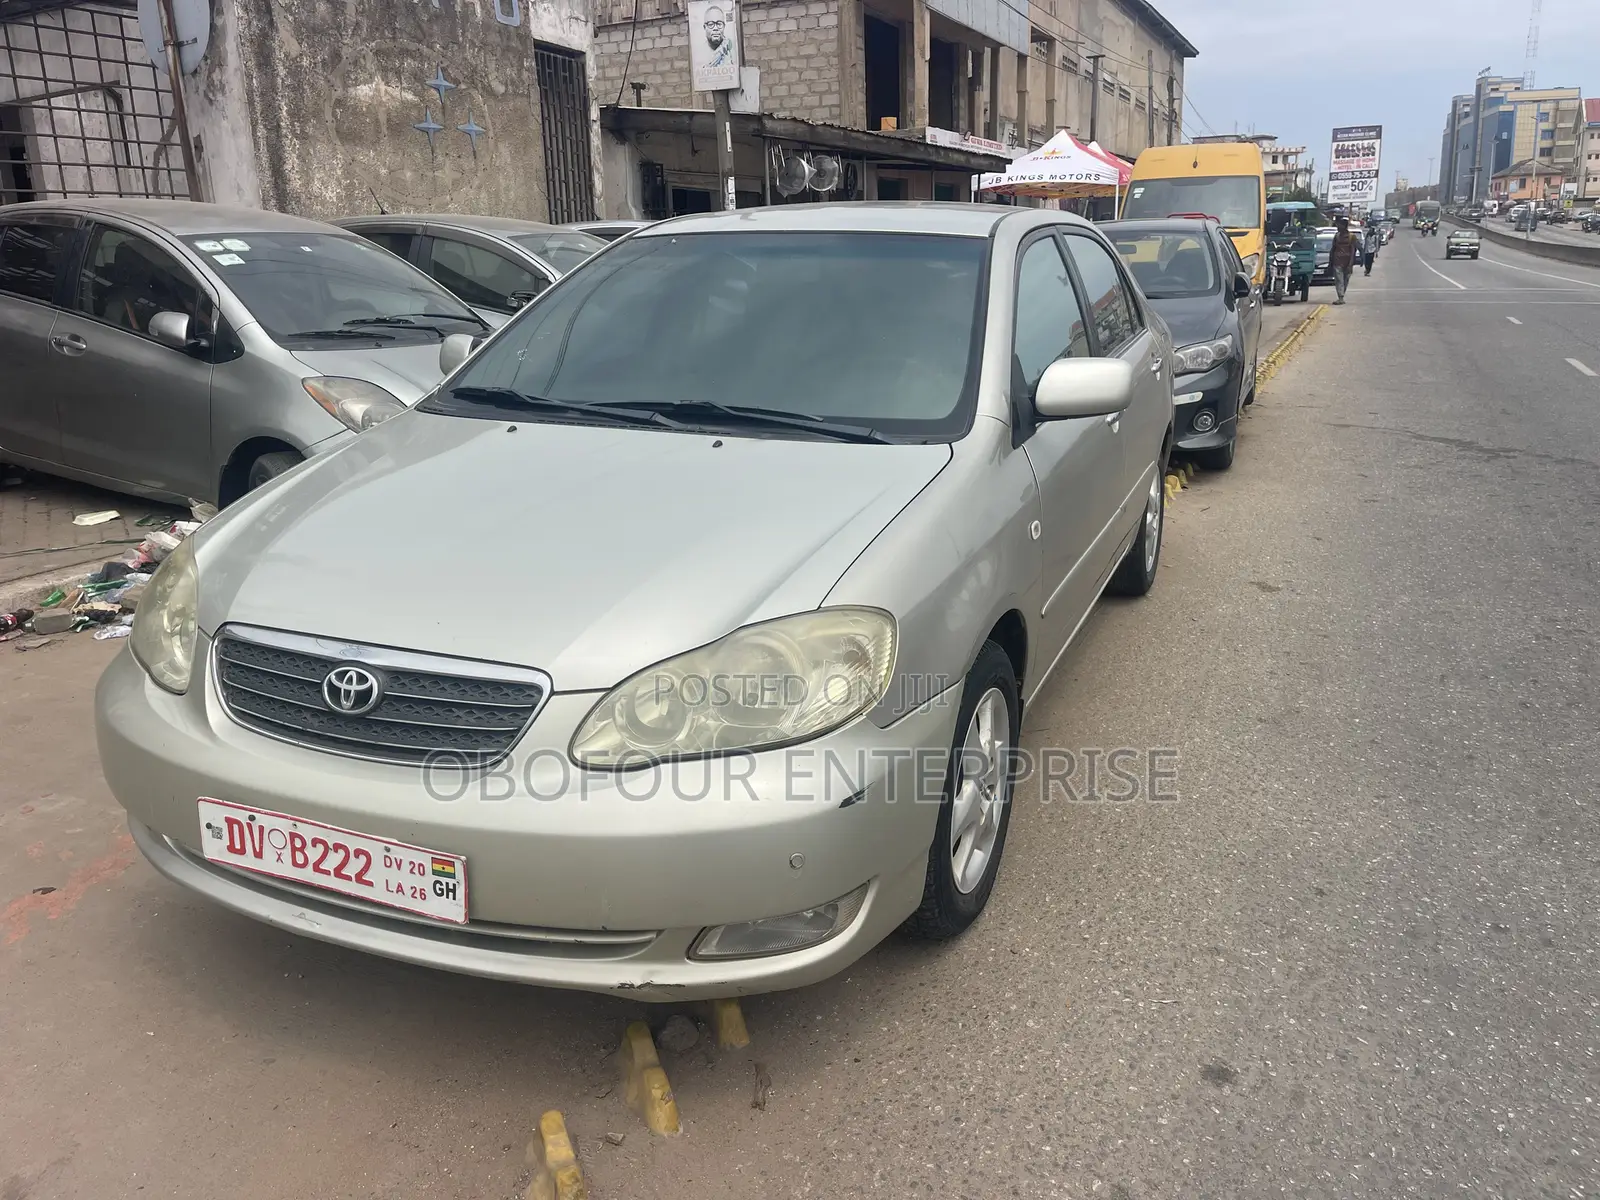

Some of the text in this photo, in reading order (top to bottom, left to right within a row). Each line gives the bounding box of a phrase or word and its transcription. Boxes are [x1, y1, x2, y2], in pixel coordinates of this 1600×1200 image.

[988, 173, 1101, 184] JB KINGS MOTORS
[1350, 180, 1373, 192] 50%
[224, 816, 375, 888] DV B222
[384, 855, 426, 876] DV 20
[385, 879, 427, 901] LA 26
[432, 880, 457, 901] GH
